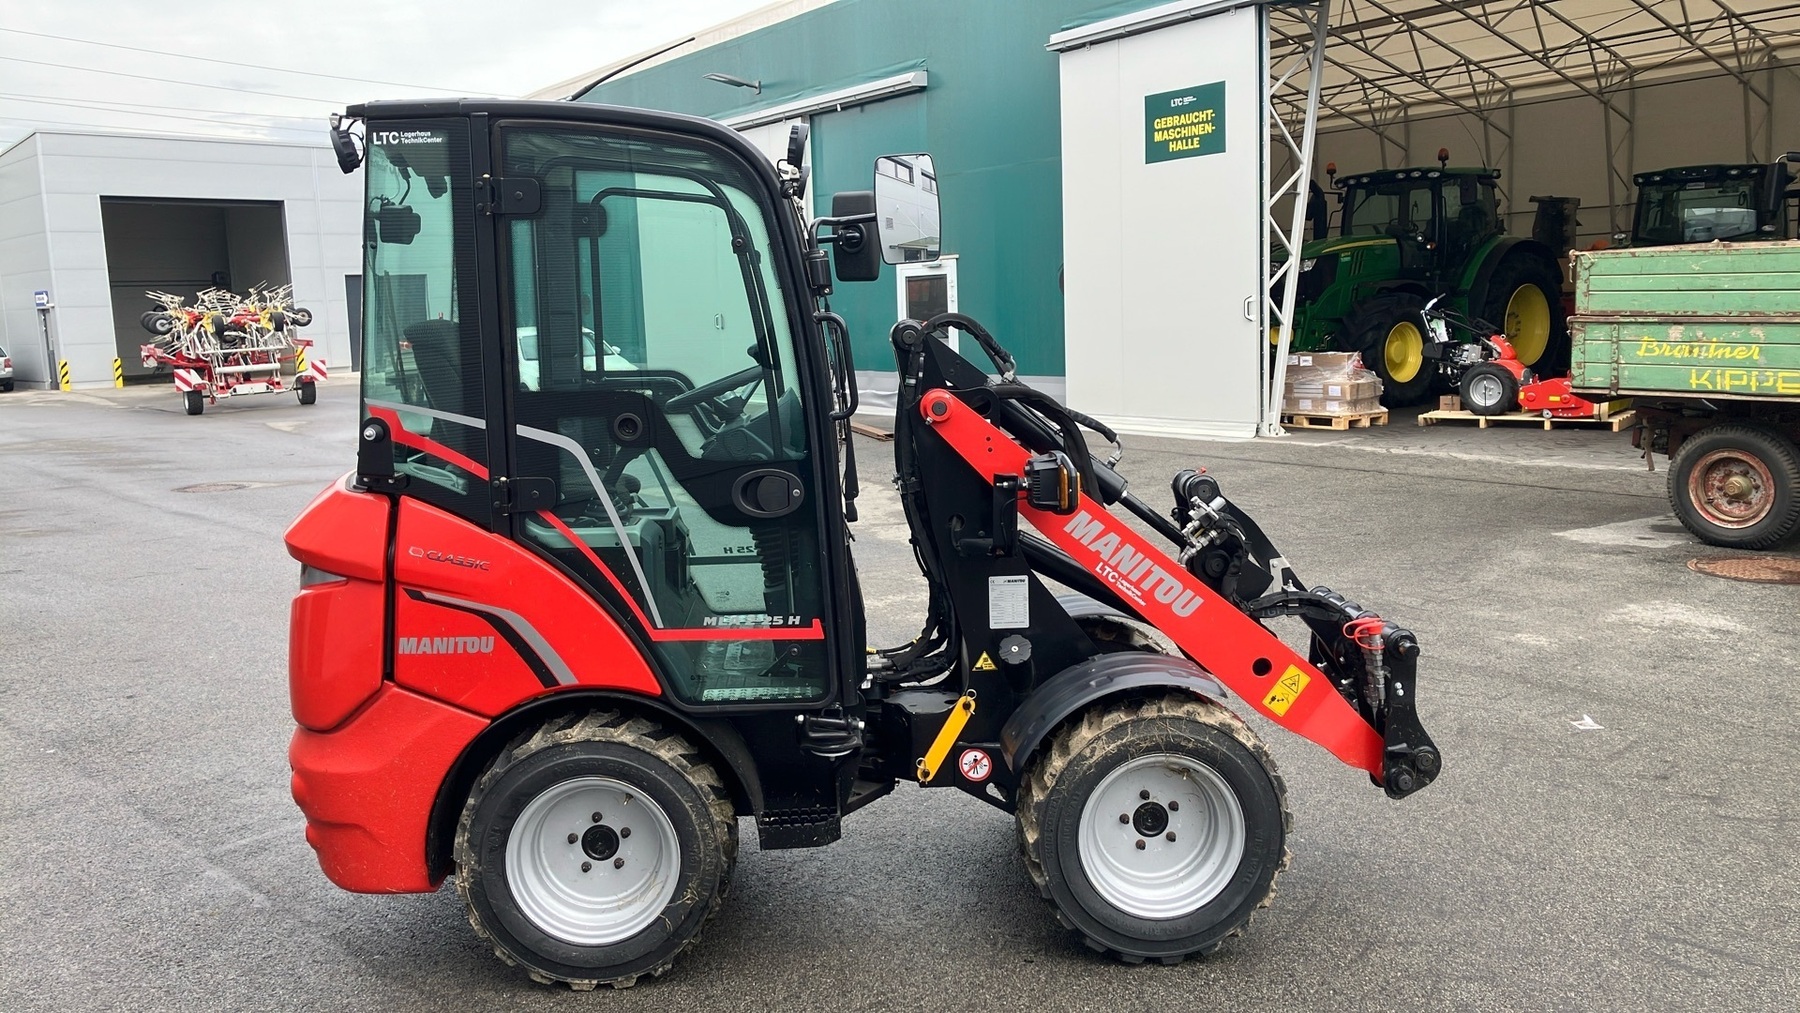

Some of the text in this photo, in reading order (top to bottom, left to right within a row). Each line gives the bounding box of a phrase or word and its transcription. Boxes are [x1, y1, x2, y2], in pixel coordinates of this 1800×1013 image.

[1171, 97, 1183, 107] LTC
[1154, 109, 1215, 130] GEBRAUCHT-
[373, 131, 399, 145] LTC
[1154, 122, 1215, 142] MASCHINEN-
[1169, 137, 1200, 152] HALLE
[1636, 336, 1760, 360] Brantner
[427, 550, 490, 571] CLASSIC
[1063, 510, 1205, 618] MANITOU
[1095, 562, 1119, 583] LTC
[788, 616, 801, 625] H
[398, 636, 495, 655] MANITOU
